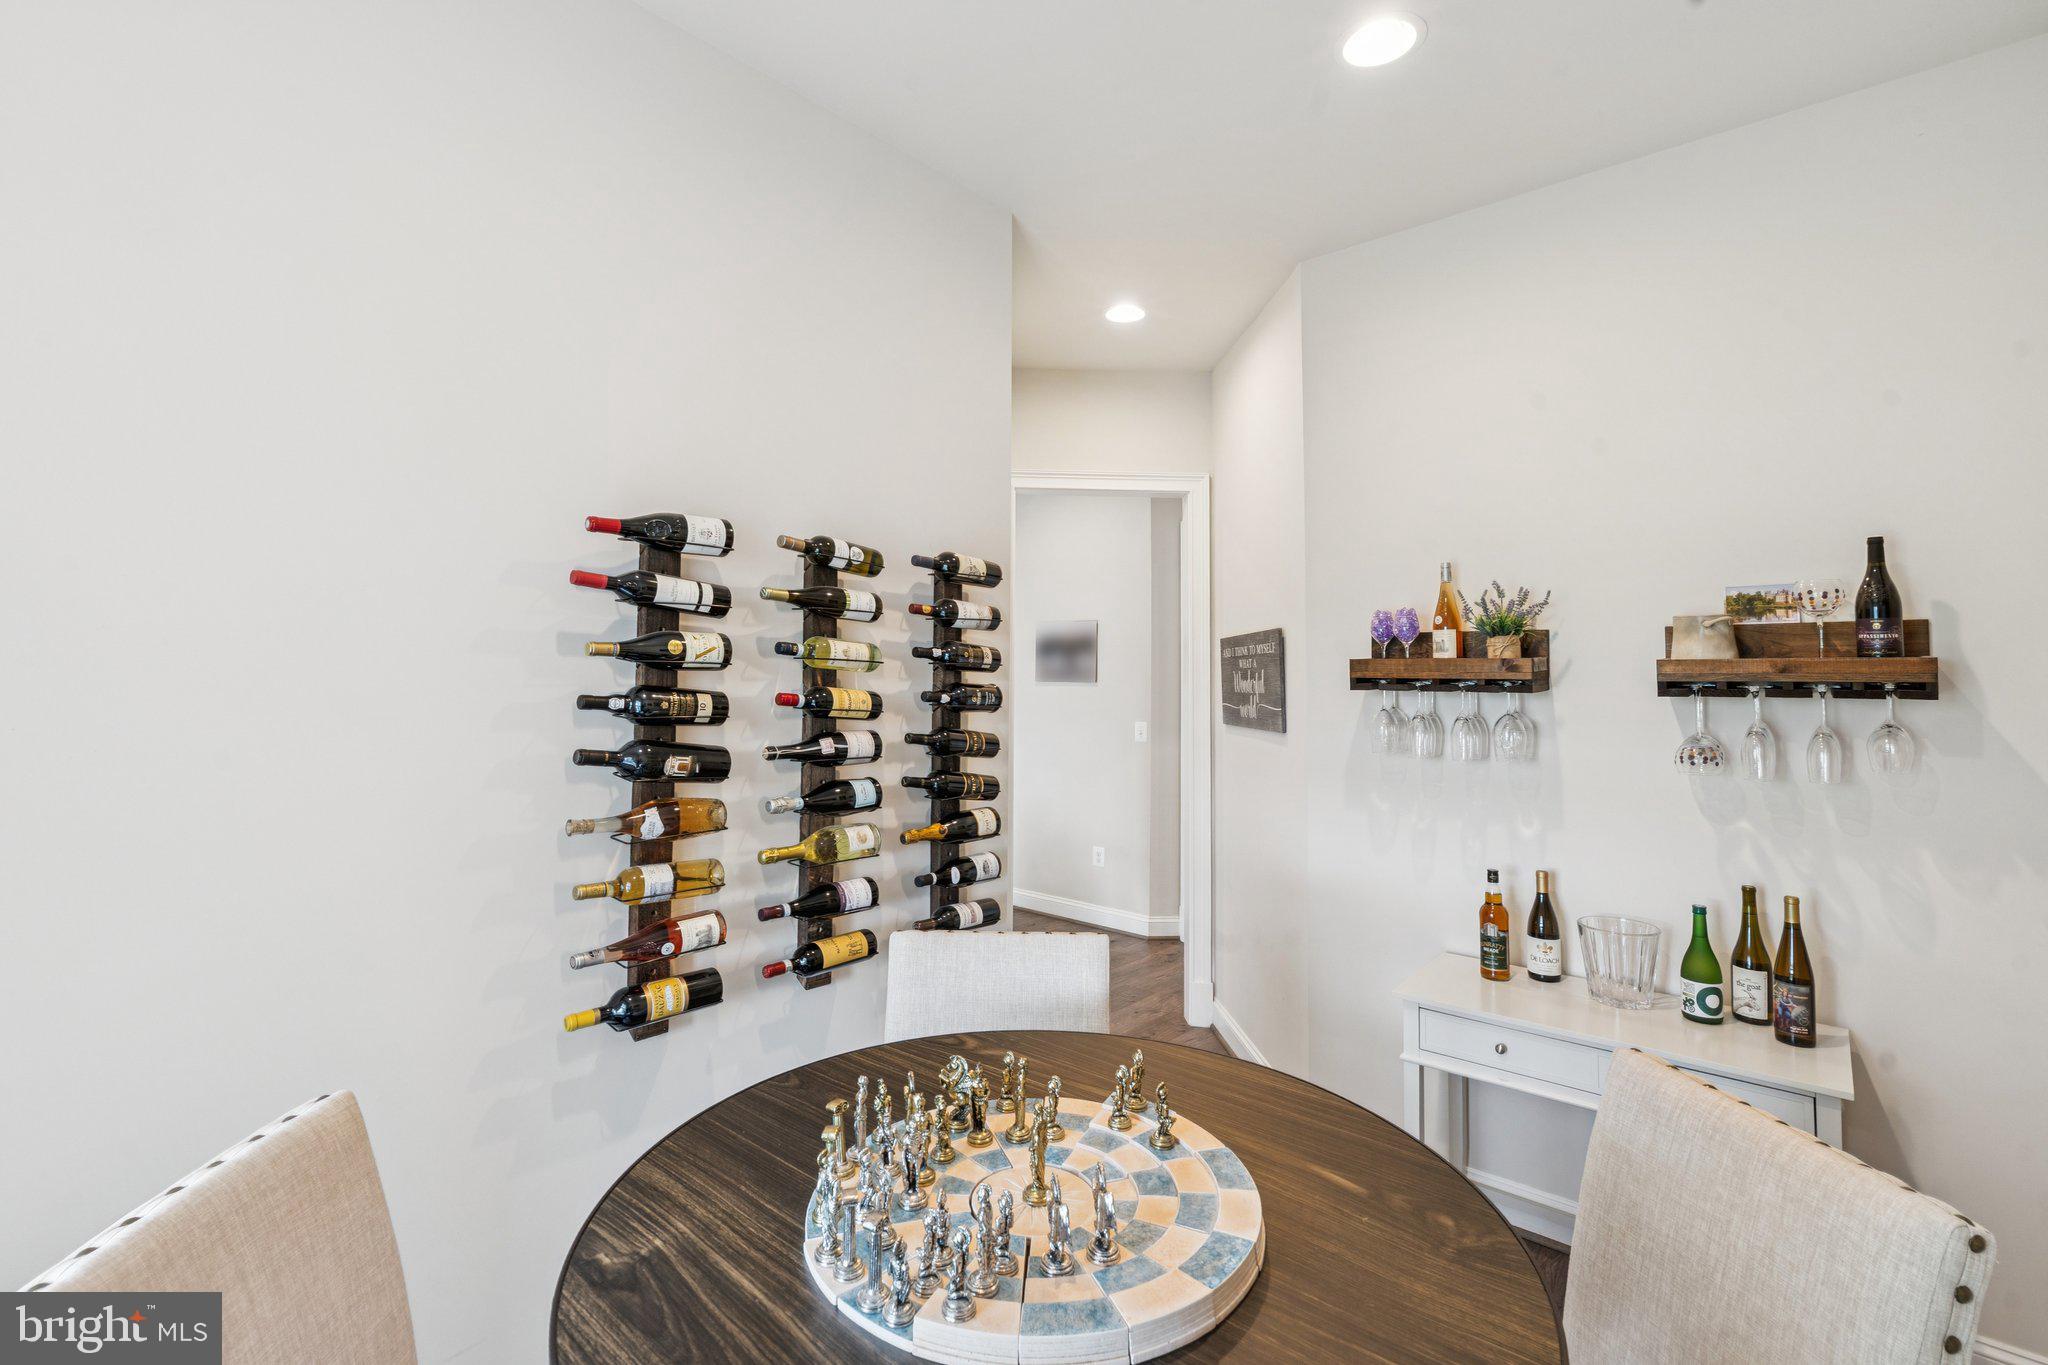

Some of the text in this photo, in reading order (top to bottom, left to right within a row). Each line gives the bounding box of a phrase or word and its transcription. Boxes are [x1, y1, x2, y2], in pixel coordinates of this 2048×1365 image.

[1235, 645, 1248, 657] THINK
[1249, 644, 1256, 656] TO
[1256, 642, 1275, 655] MYSELF
[1239, 658, 1252, 669] WHAT
[700, 702, 707, 711] 10
